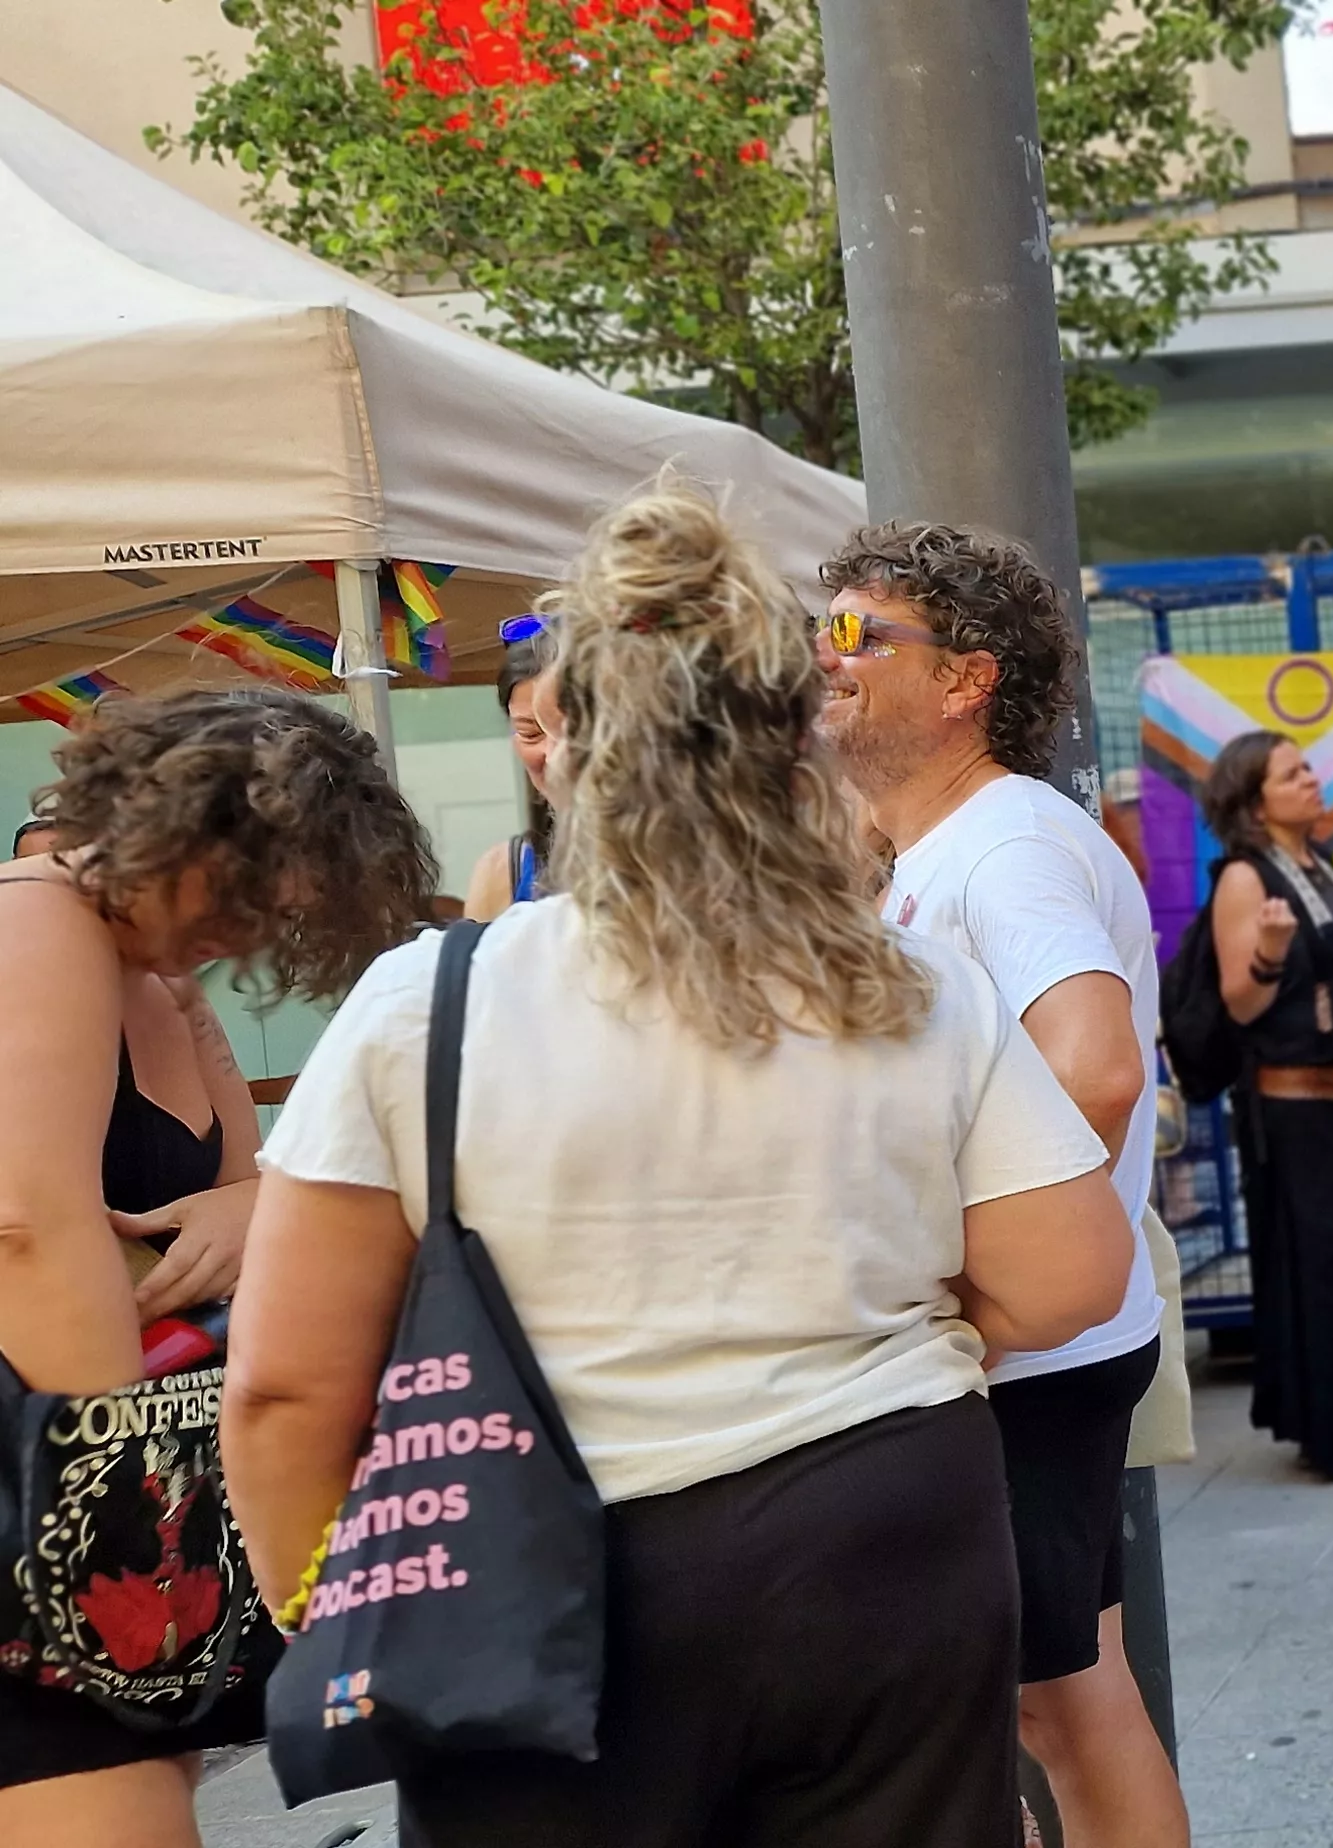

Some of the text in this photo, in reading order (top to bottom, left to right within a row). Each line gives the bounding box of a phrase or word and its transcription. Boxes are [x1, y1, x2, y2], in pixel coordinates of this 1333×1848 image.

[103, 539, 263, 564] MASTERTENT
[161, 1366, 226, 1393] QUIER
[381, 1352, 472, 1401] cas
